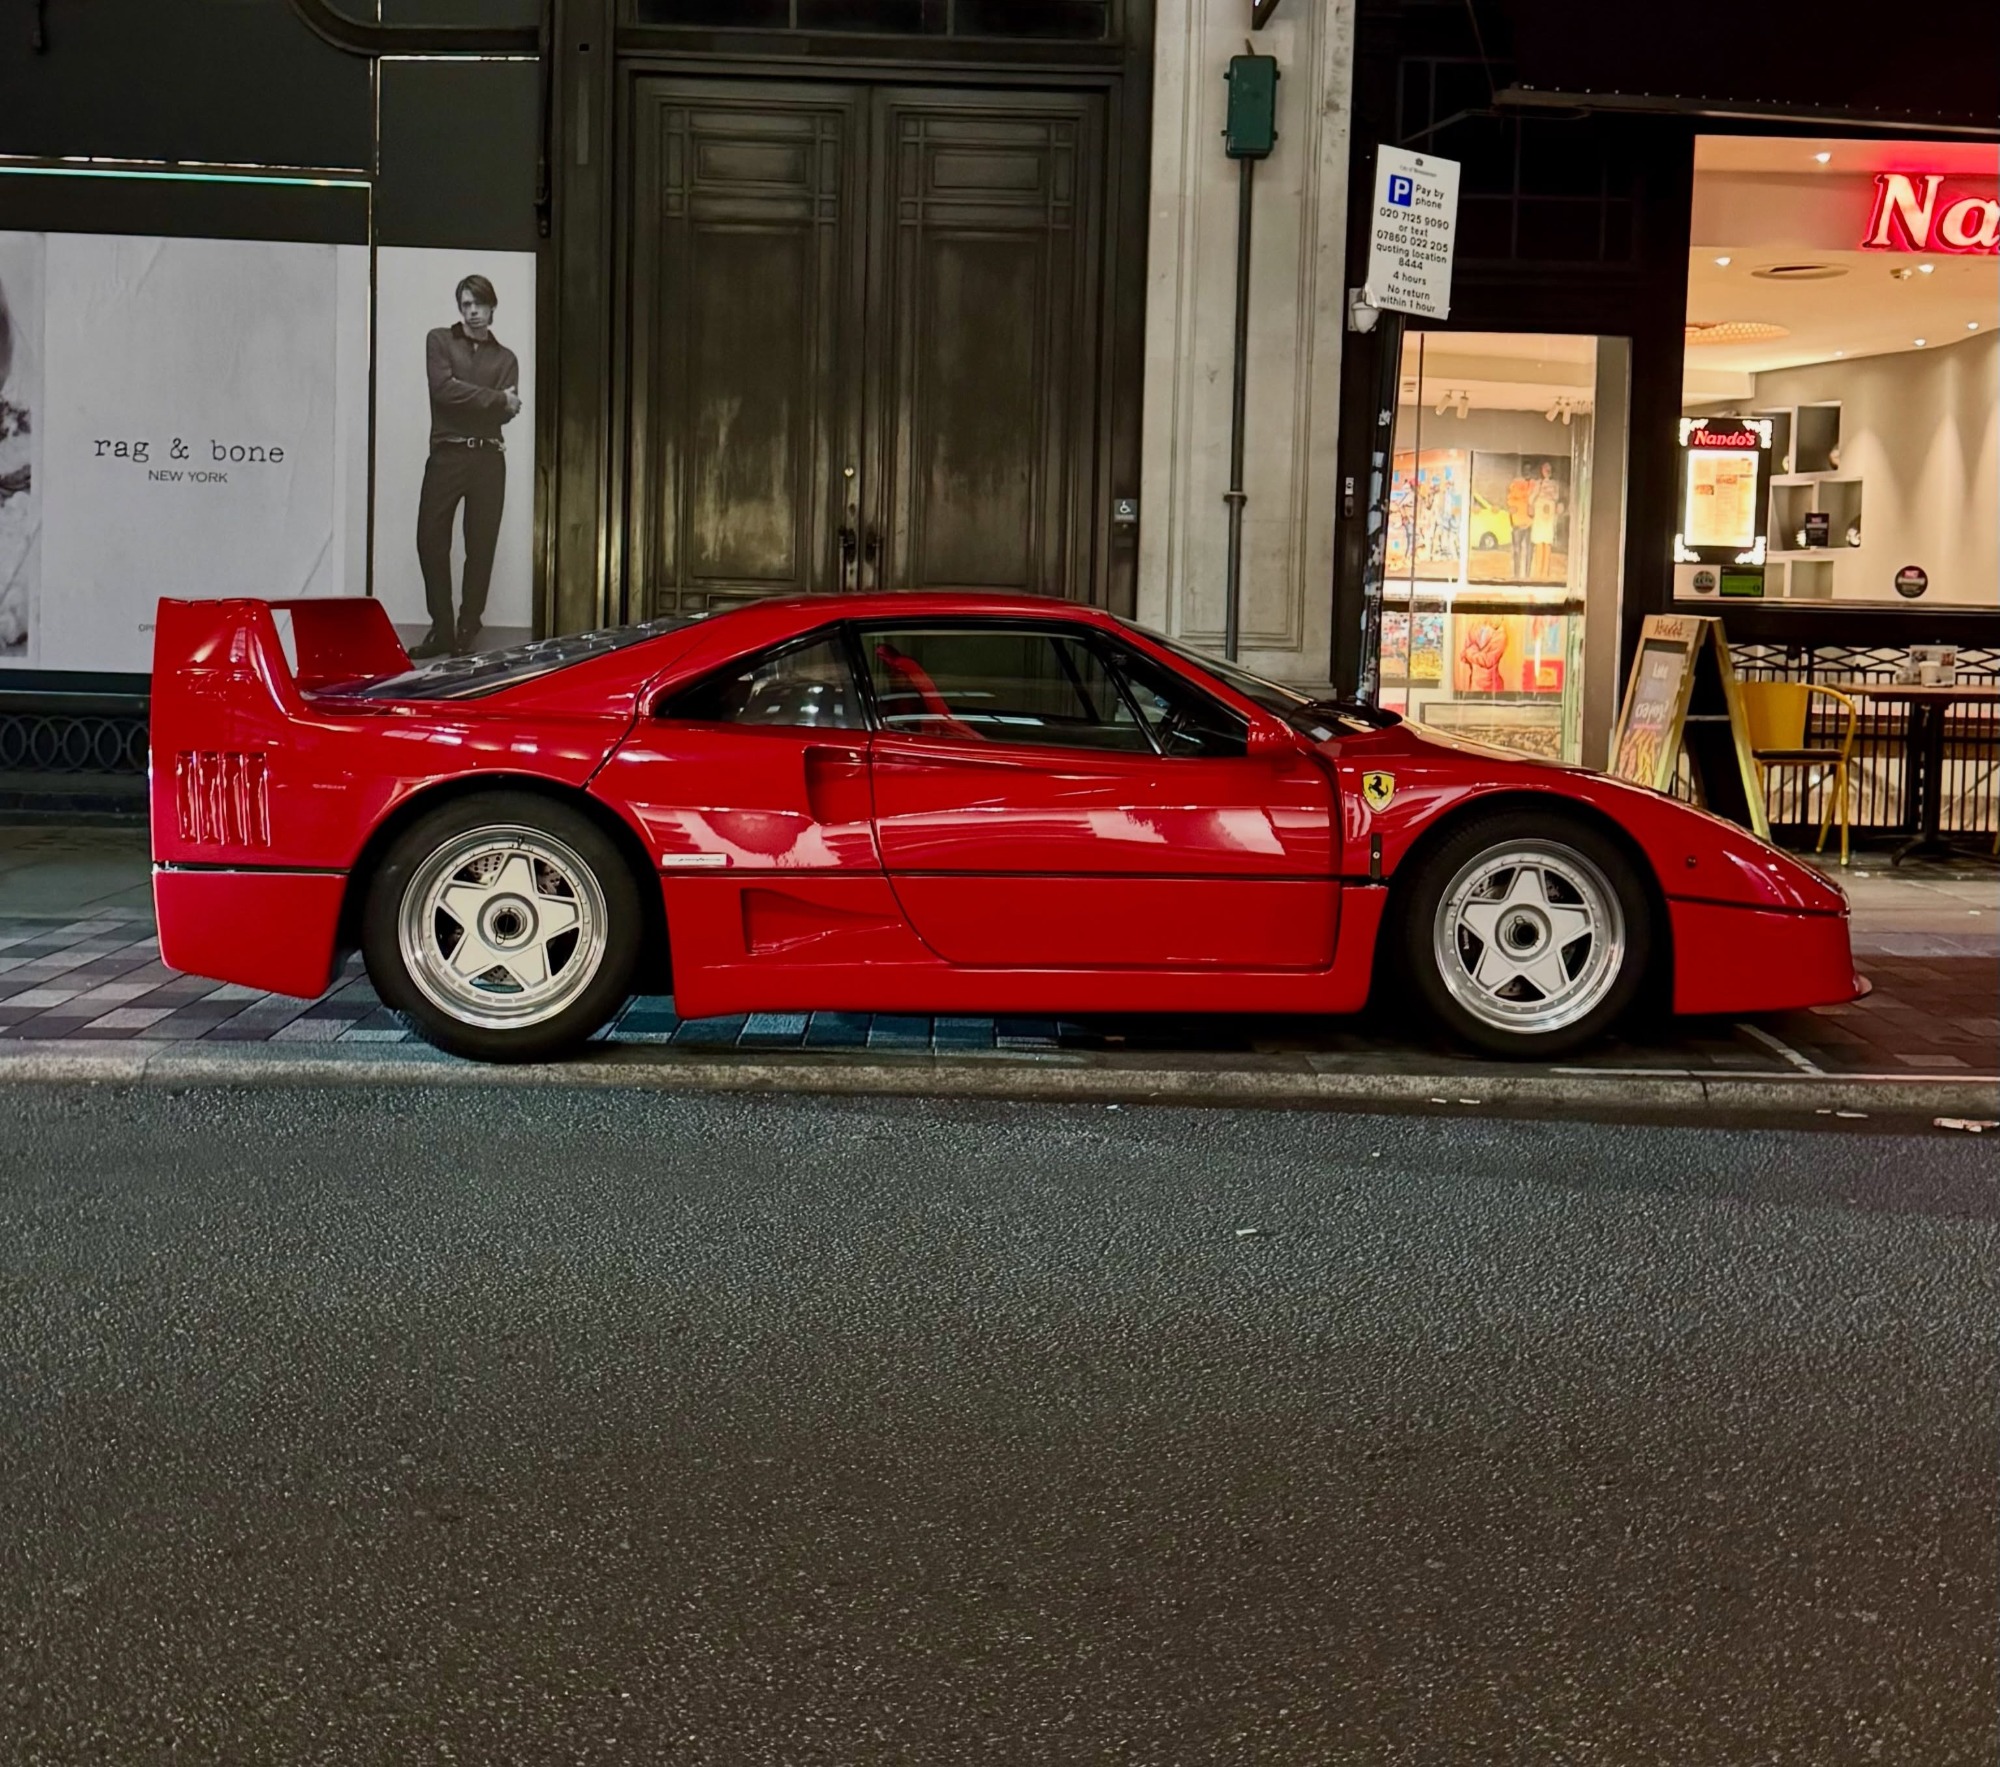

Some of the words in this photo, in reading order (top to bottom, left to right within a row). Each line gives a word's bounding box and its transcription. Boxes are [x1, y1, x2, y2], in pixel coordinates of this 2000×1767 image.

[1415, 183, 1431, 197] Pay
[1434, 188, 1445, 200] by
[1415, 197, 1442, 209] phone
[1379, 206, 1399, 219] 020
[1401, 211, 1422, 224] 7125
[1424, 216, 1449, 230] 9090
[1862, 173, 2000, 251] Na
[1398, 224, 1408, 233] or
[1410, 226, 1428, 237] text
[1376, 229, 1407, 244] 07860
[1410, 236, 1428, 249] 022
[1430, 240, 1448, 253] 205
[1376, 242, 1410, 257] quoting
[1412, 248, 1447, 264] location
[1398, 257, 1423, 270] 8444
[1393, 270, 1399, 280] 4
[1401, 272, 1427, 286] hours
[1387, 283, 1400, 295] No
[1402, 288, 1430, 300] return
[1380, 295, 1407, 307] within
[1409, 299, 1414, 309] 1
[1415, 300, 1436, 313] hour
[1694, 430, 1756, 446] Nando's
[94, 439, 149, 463] rag
[170, 437, 190, 460] &
[211, 439, 285, 463] bone
[148, 469, 184, 482] NEW
[188, 471, 228, 483] YORK
